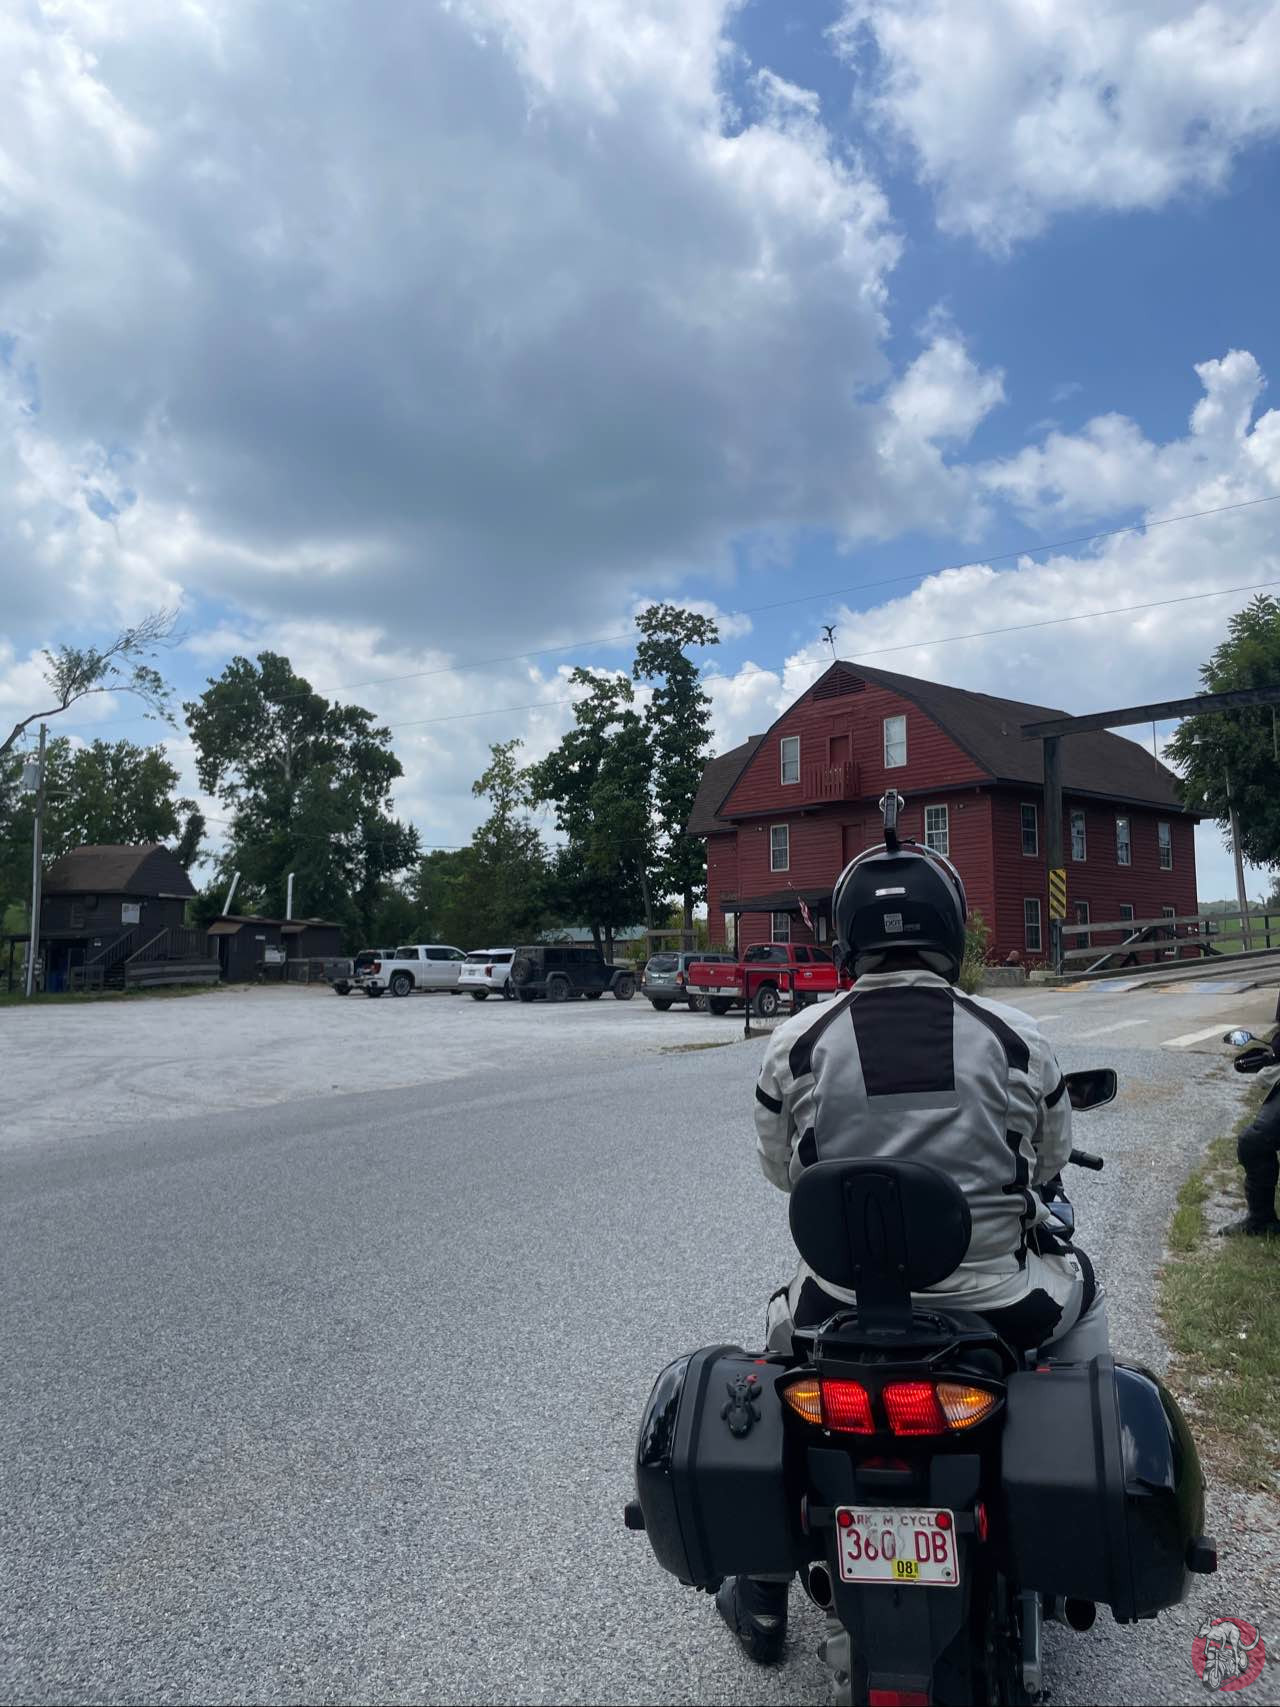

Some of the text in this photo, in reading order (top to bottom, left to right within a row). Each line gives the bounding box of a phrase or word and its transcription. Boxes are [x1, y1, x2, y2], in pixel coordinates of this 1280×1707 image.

[900, 1515, 934, 1527] CYCL
[846, 1529, 948, 1563] 360 DB
[897, 1560, 913, 1574] 08
